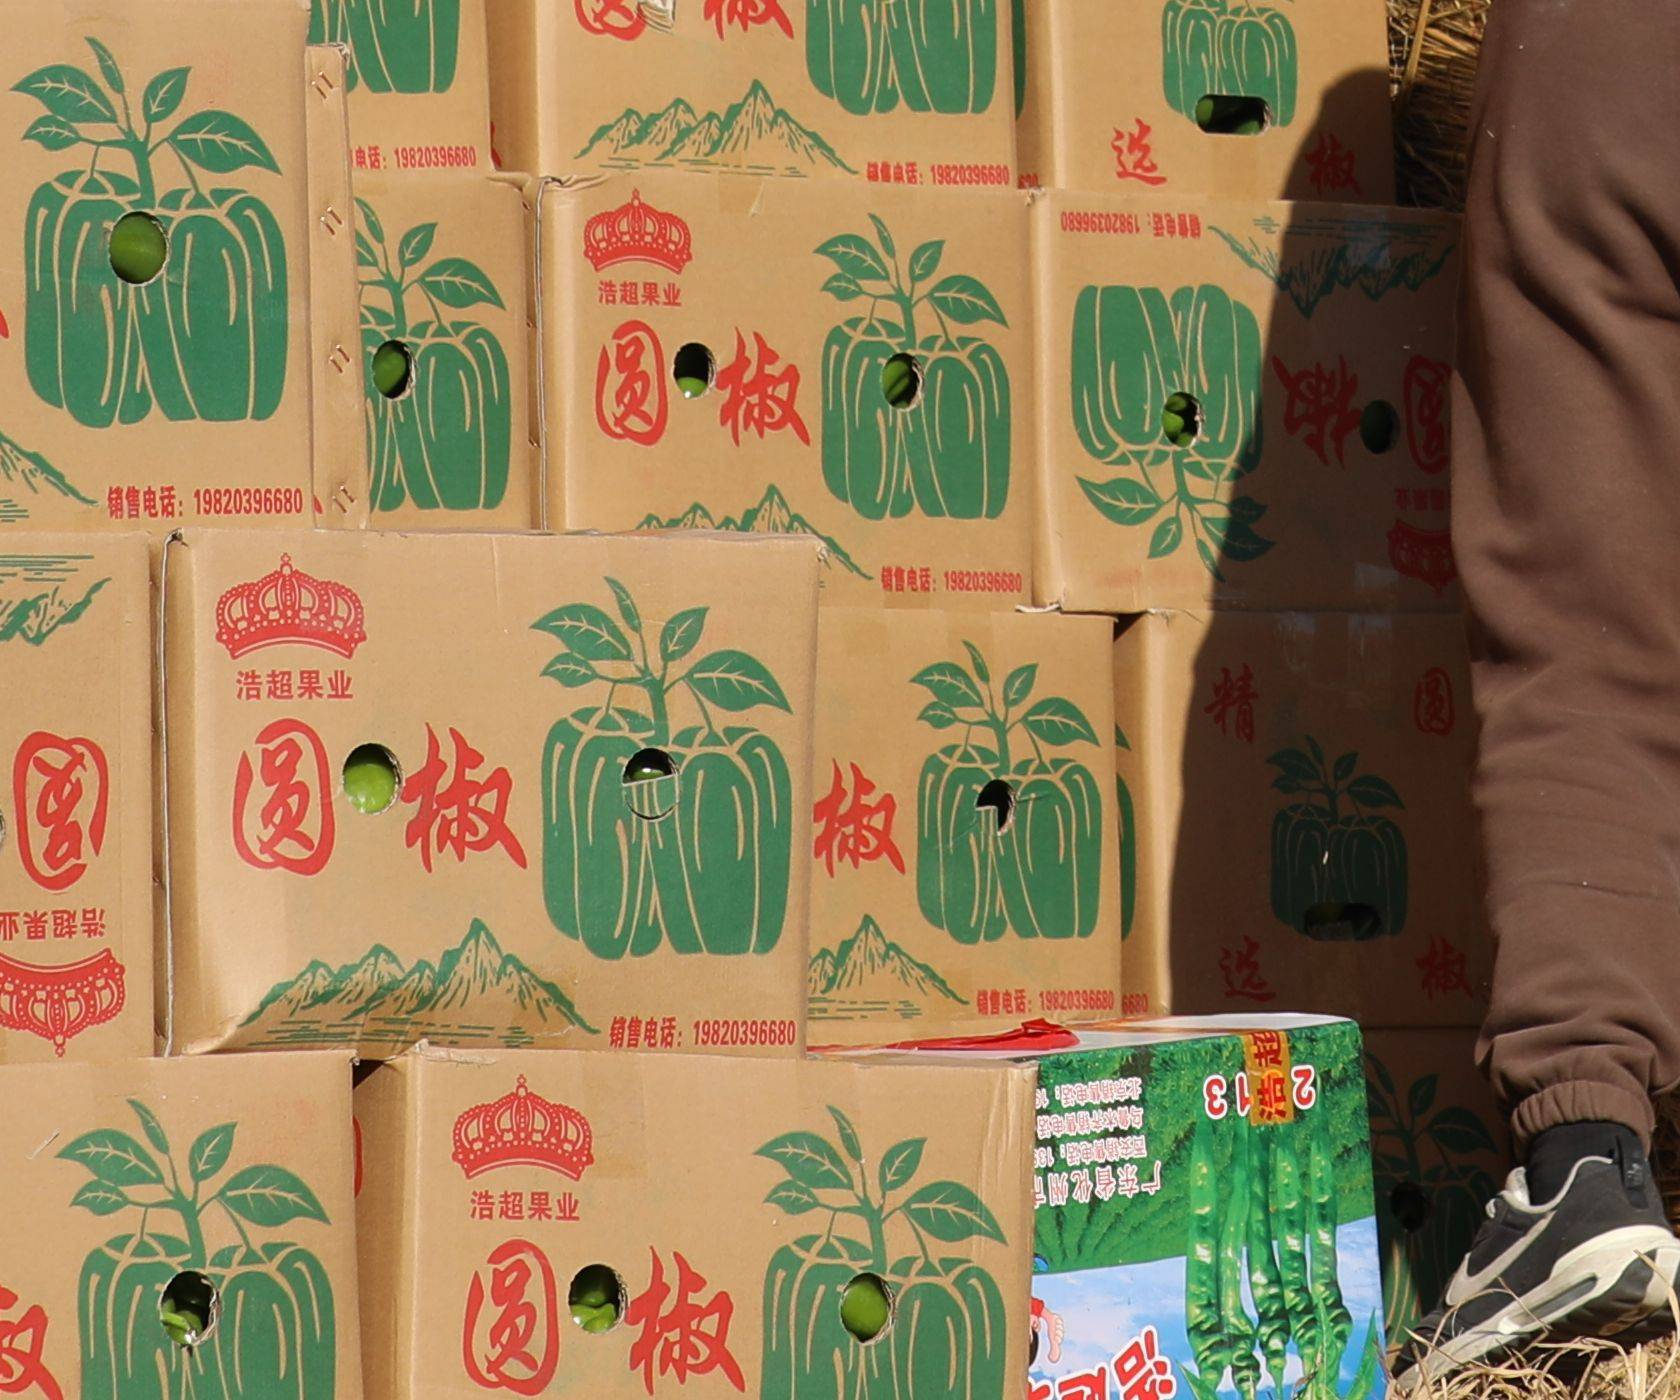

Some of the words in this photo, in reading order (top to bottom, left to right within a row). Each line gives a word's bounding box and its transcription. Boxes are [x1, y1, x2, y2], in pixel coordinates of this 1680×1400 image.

[356, 147, 476, 169] 电话：19820396680
[1111, 119, 1167, 186] 选
[599, 281, 681, 306] 浩超果业
[596, 320, 811, 446] 圆椒
[238, 670, 352, 700] 浩超果业
[233, 719, 527, 876] 圆椒
[813, 760, 906, 877] 椒
[471, 1191, 579, 1221] 浩超果业
[463, 1239, 745, 1396] 圆椒
